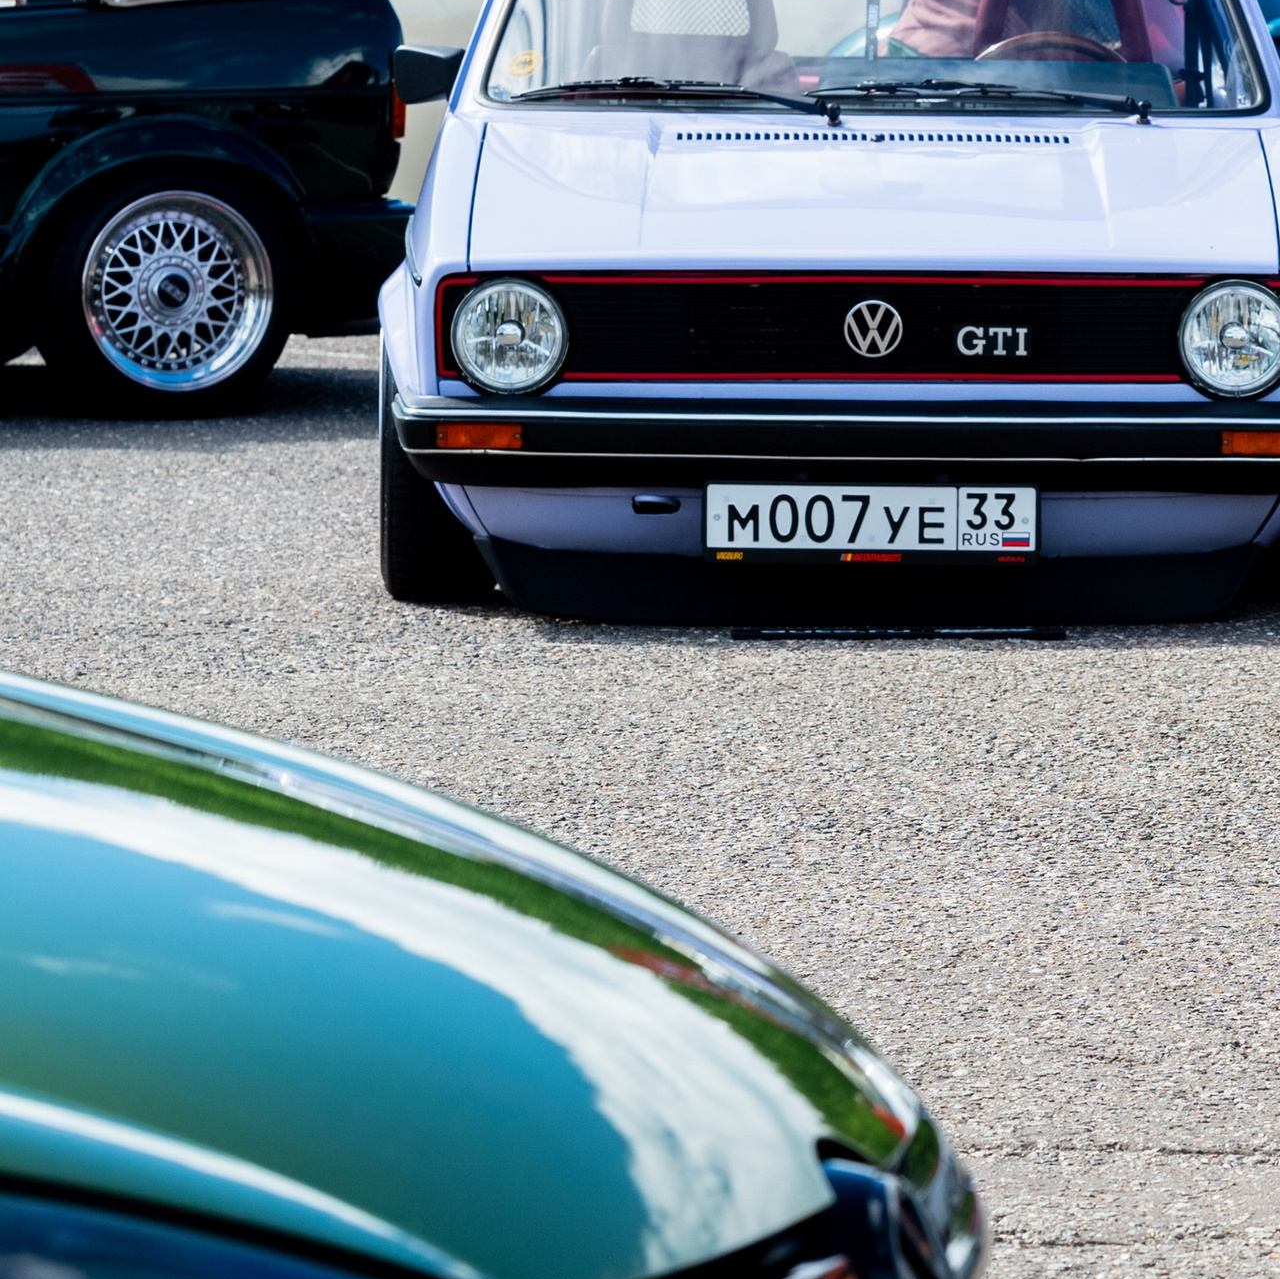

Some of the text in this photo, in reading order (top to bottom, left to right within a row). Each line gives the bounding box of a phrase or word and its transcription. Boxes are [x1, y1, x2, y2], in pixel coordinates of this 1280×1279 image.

[956, 325, 1028, 356] GTI
[965, 492, 1017, 531] 33
[961, 532, 1000, 547] RUS
